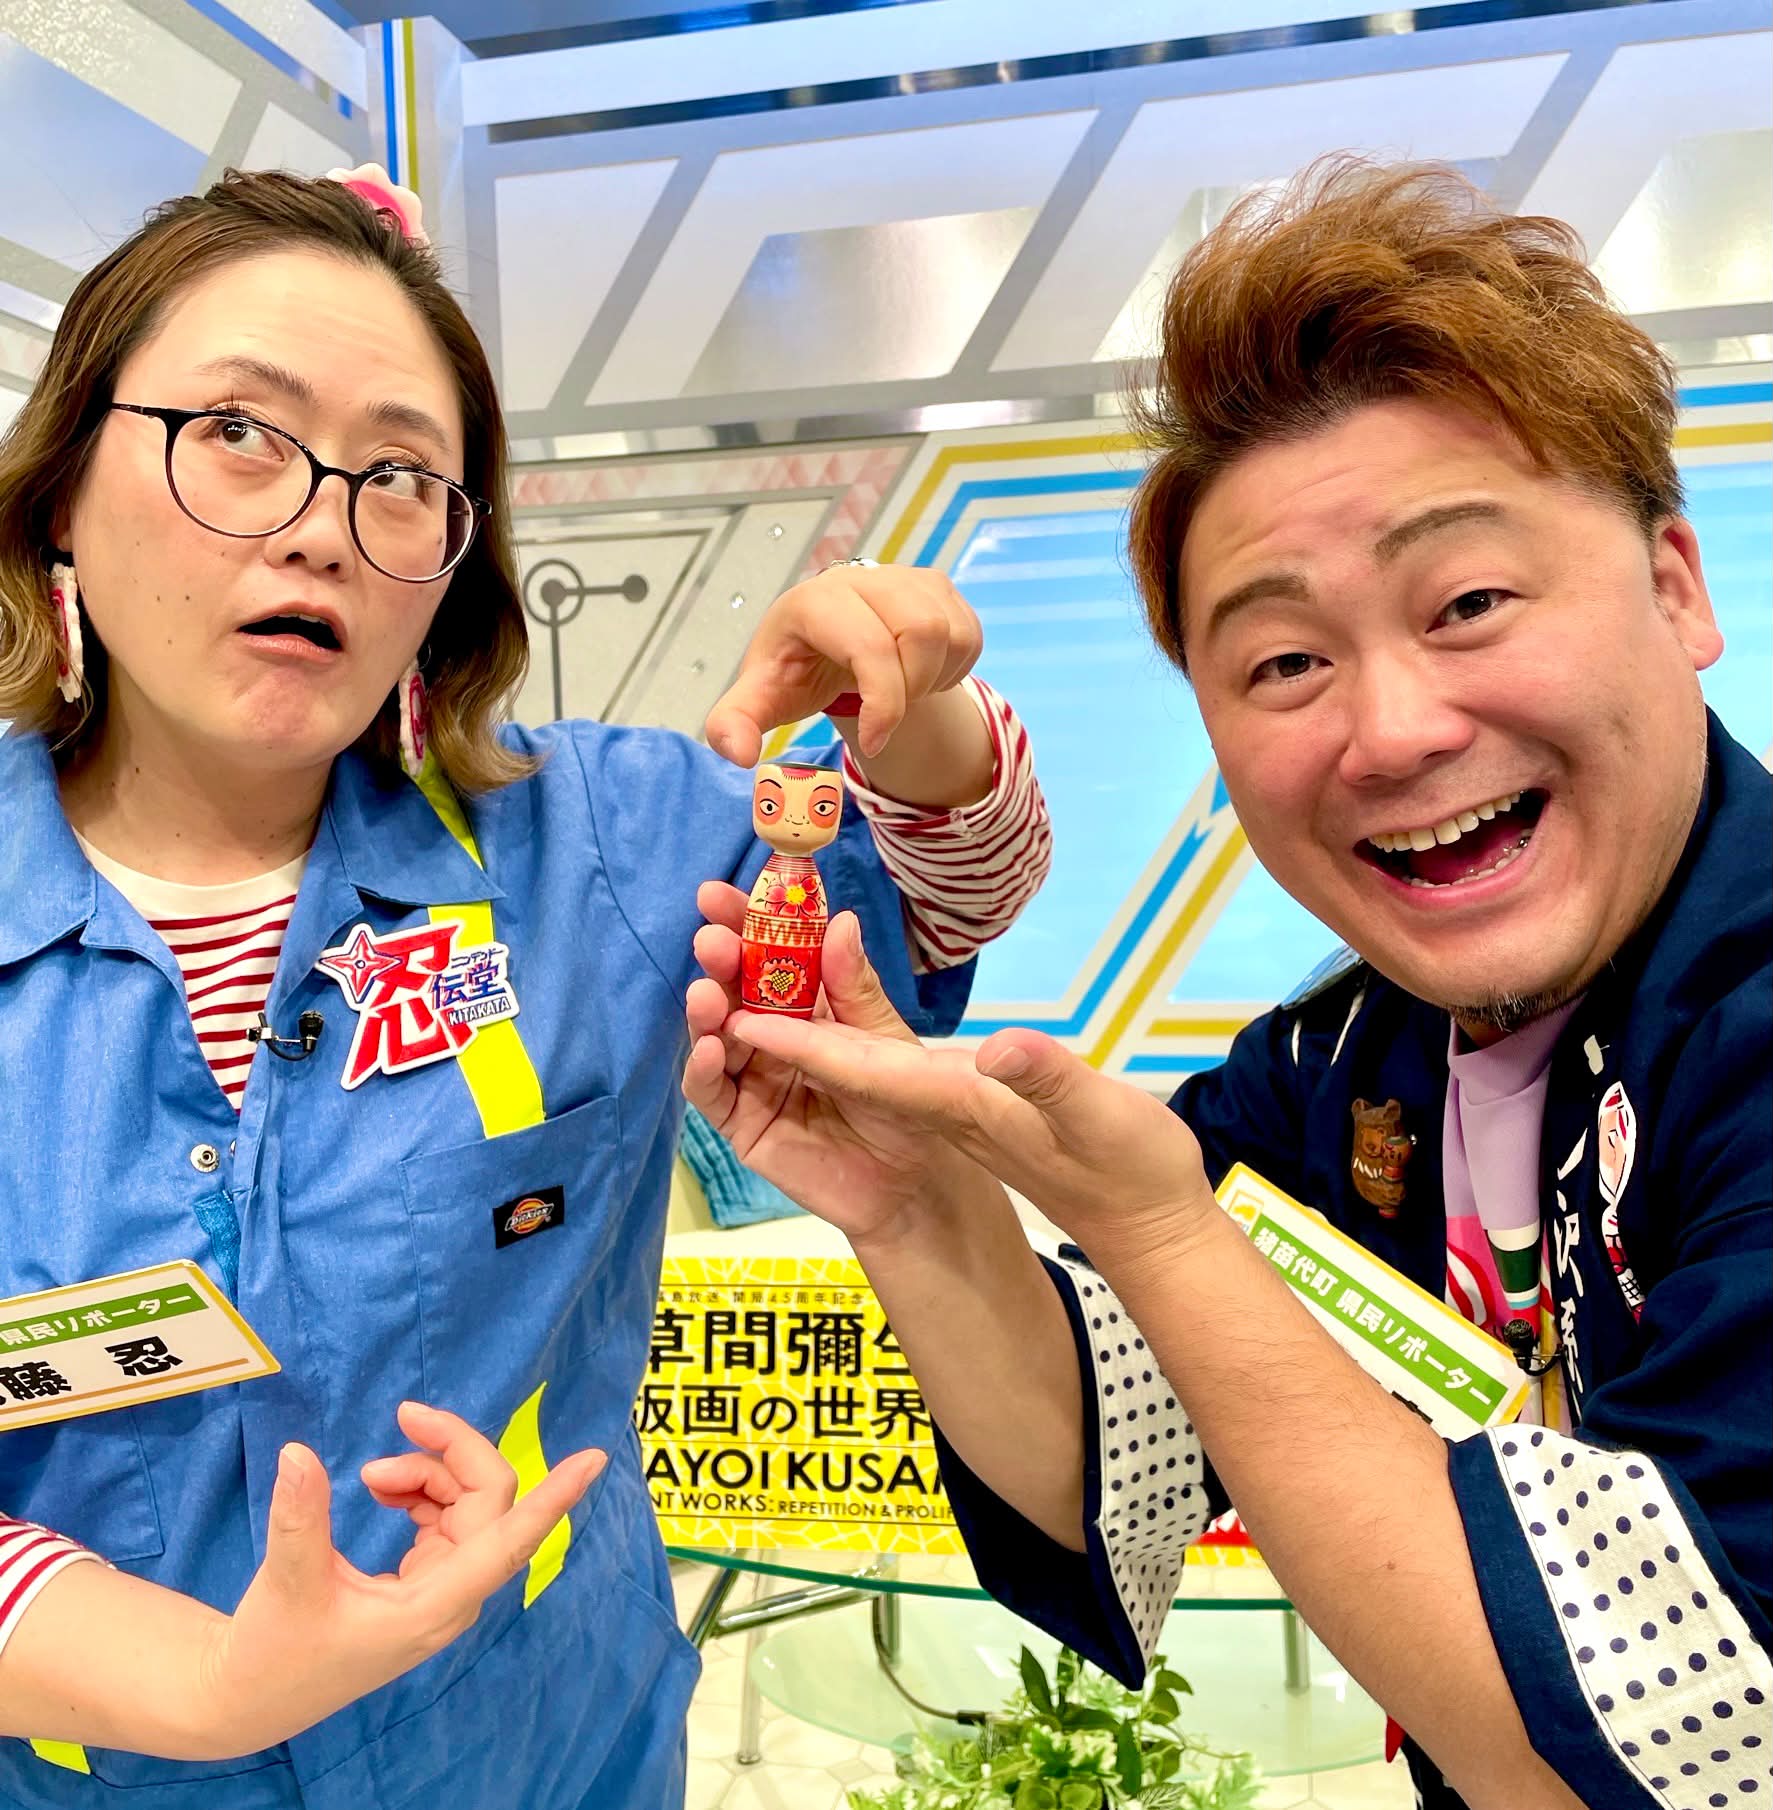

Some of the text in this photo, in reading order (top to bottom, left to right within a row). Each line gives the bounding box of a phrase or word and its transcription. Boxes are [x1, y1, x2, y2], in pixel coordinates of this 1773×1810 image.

[429, 960, 507, 1009] 伝堂
[448, 996, 512, 1027] KITAKATA
[0, 1295, 192, 1346] 県民リポーター
[1253, 1226, 1492, 1406] 猪苗代町 県民リポーター
[0, 1335, 183, 1405] 藤 忍
[680, 1493, 774, 1512] WORKS:
[778, 1501, 876, 1517] REPETITION
[880, 1505, 891, 1517] &
